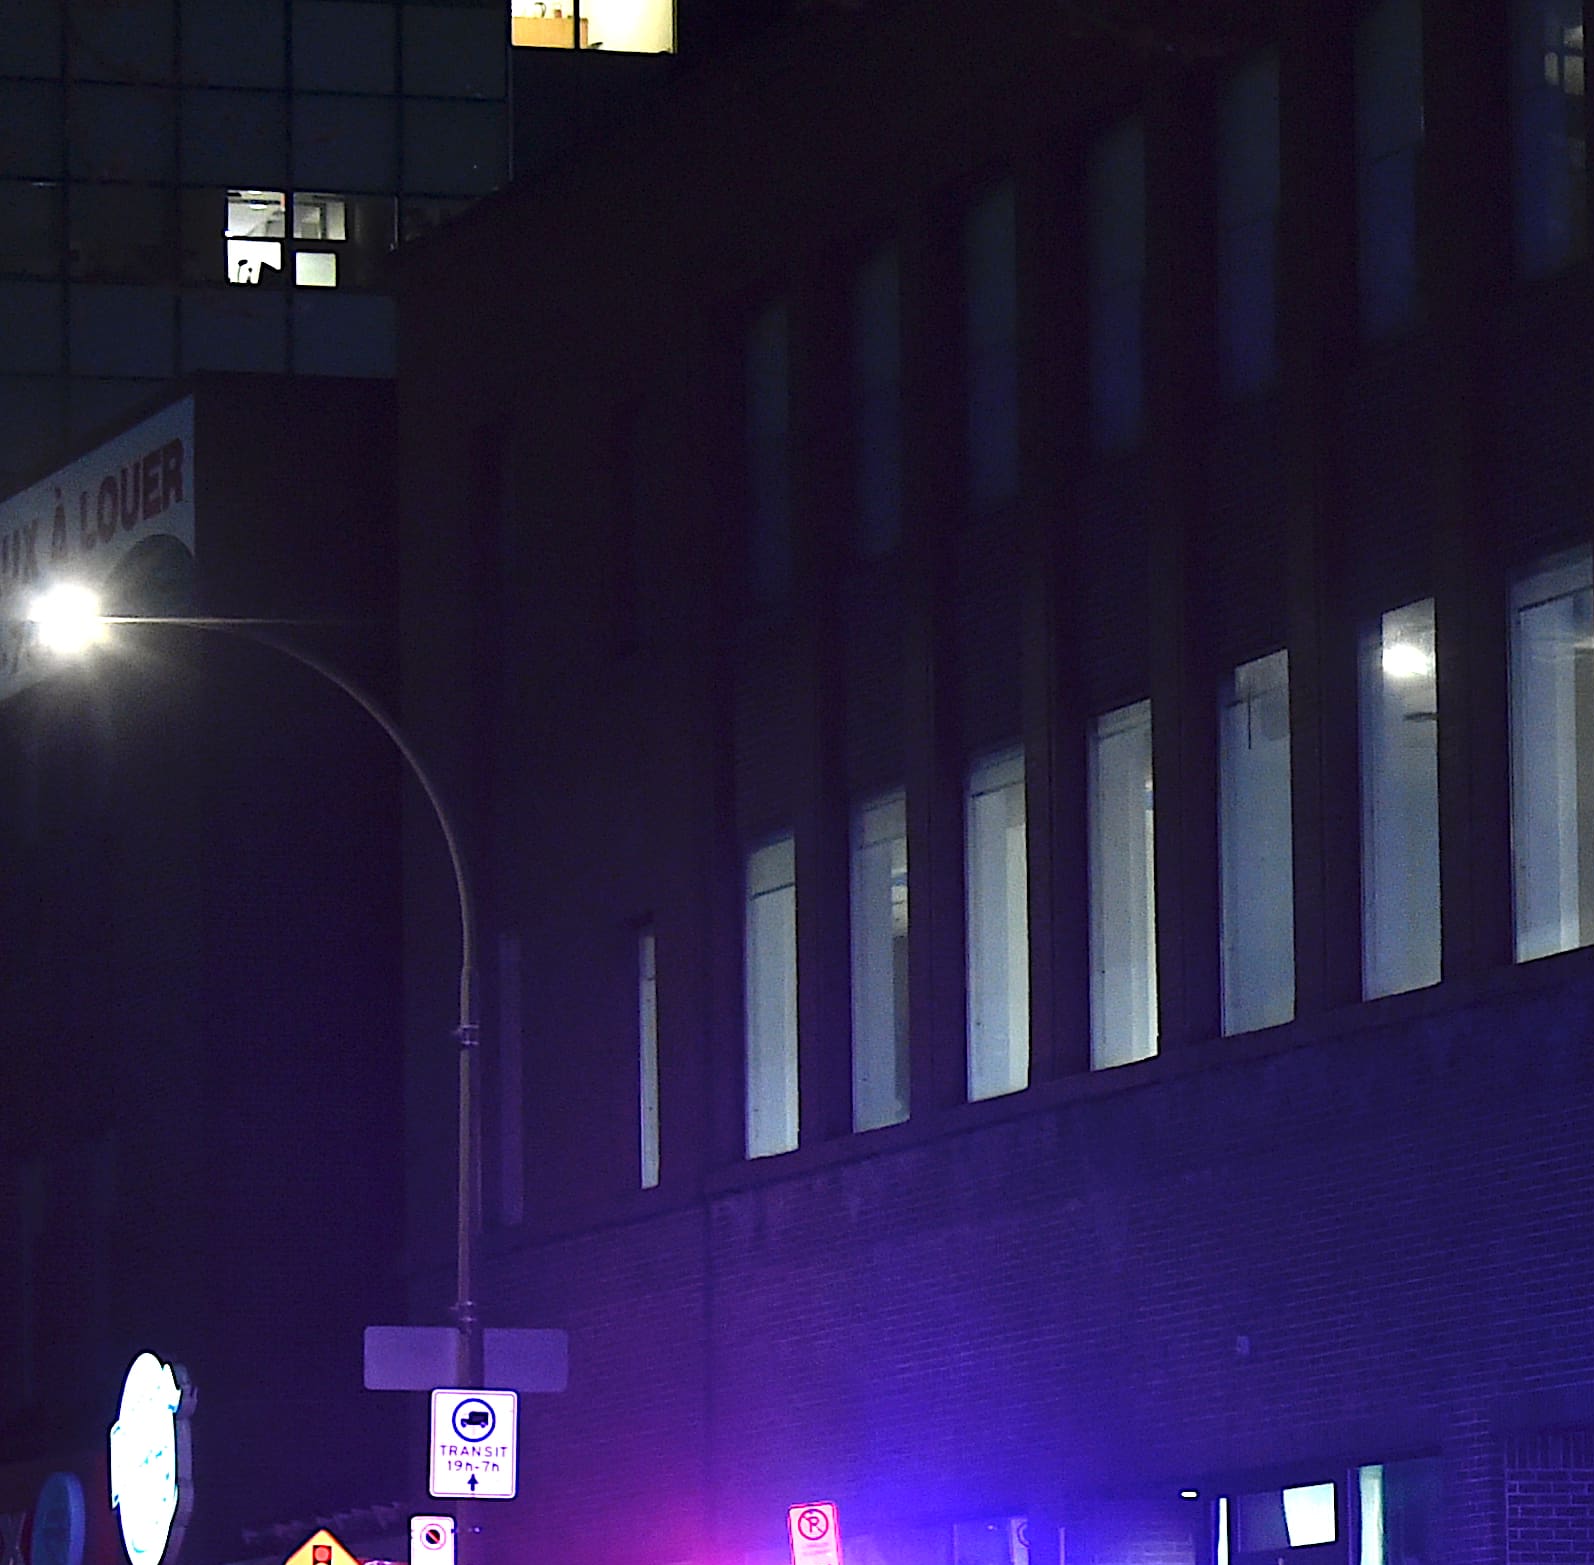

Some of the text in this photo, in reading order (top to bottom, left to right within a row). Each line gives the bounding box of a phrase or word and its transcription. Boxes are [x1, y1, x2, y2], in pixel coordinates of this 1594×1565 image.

[79, 437, 184, 550] LOUER
[440, 1444, 508, 1458] TRANSIT
[447, 1459, 500, 1472] 19h-7h
